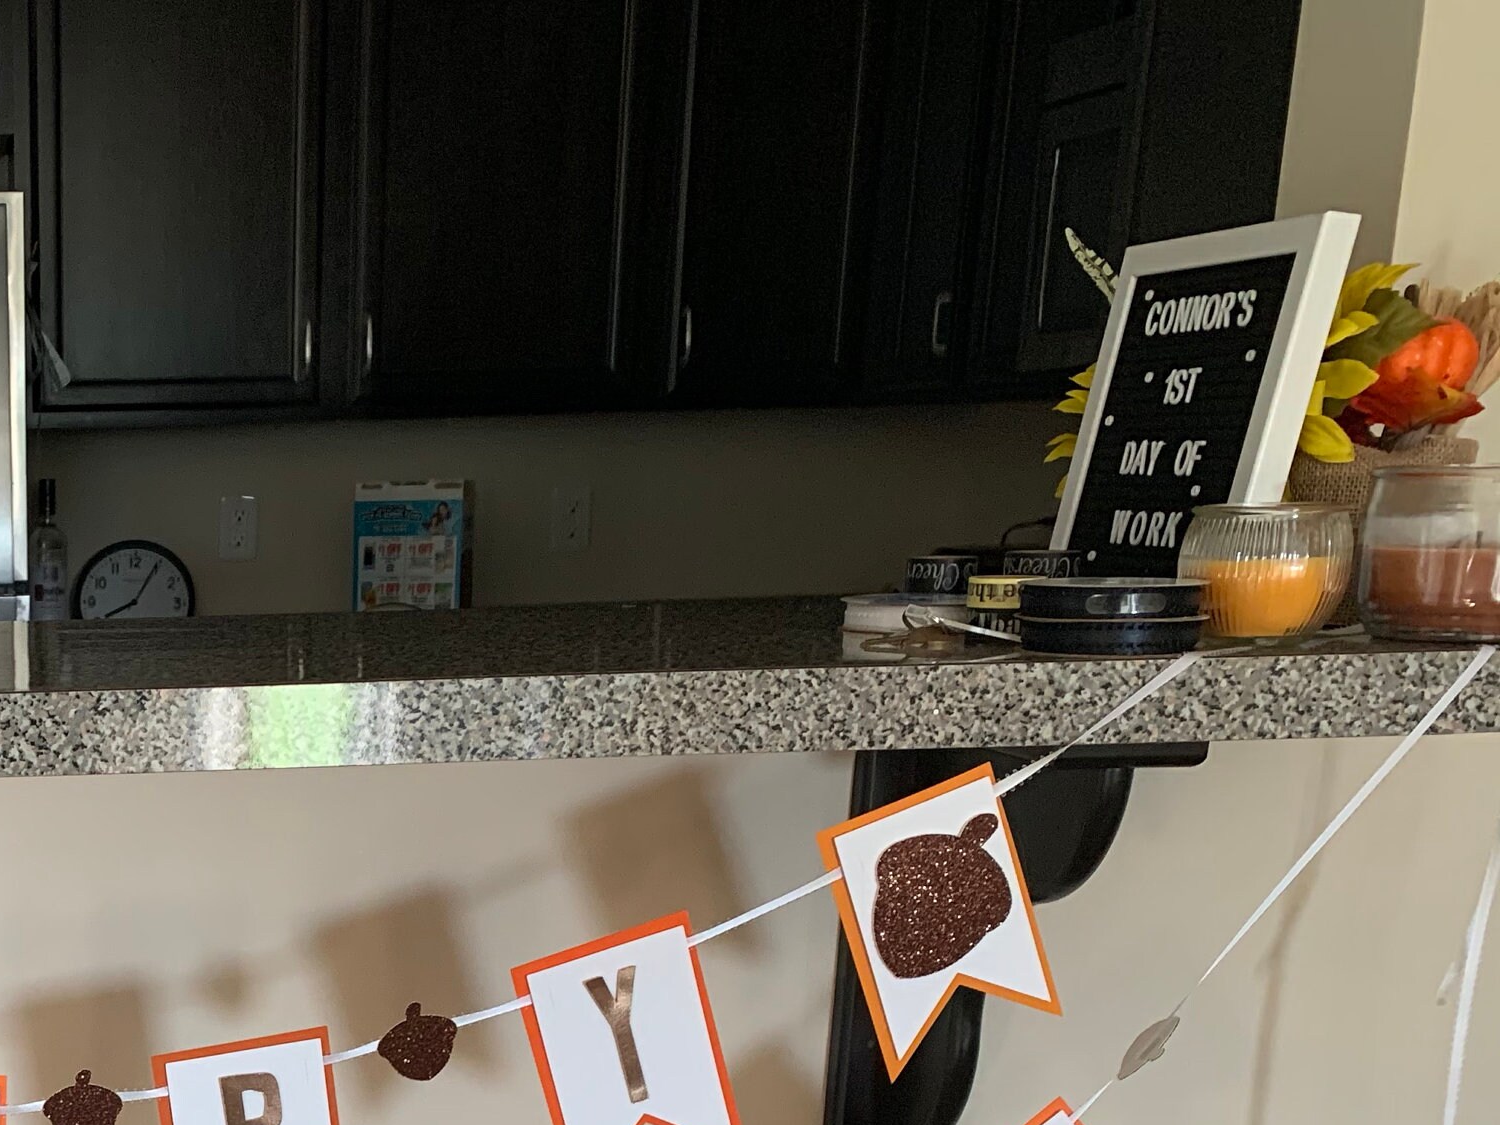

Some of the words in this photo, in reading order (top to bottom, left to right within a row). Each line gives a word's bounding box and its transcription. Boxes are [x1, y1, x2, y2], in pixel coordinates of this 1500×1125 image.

[1145, 289, 1258, 337] CONNOR'S
[1163, 367, 1202, 405] 1ST
[1119, 439, 1166, 476] DAY
[1174, 440, 1206, 477] OF
[1109, 509, 1183, 548] WORK
[111, 563, 120, 575] 11
[129, 557, 142, 569] 12
[95, 576, 107, 589] 10
[88, 595, 96, 608] 9
[173, 597, 182, 609] 3
